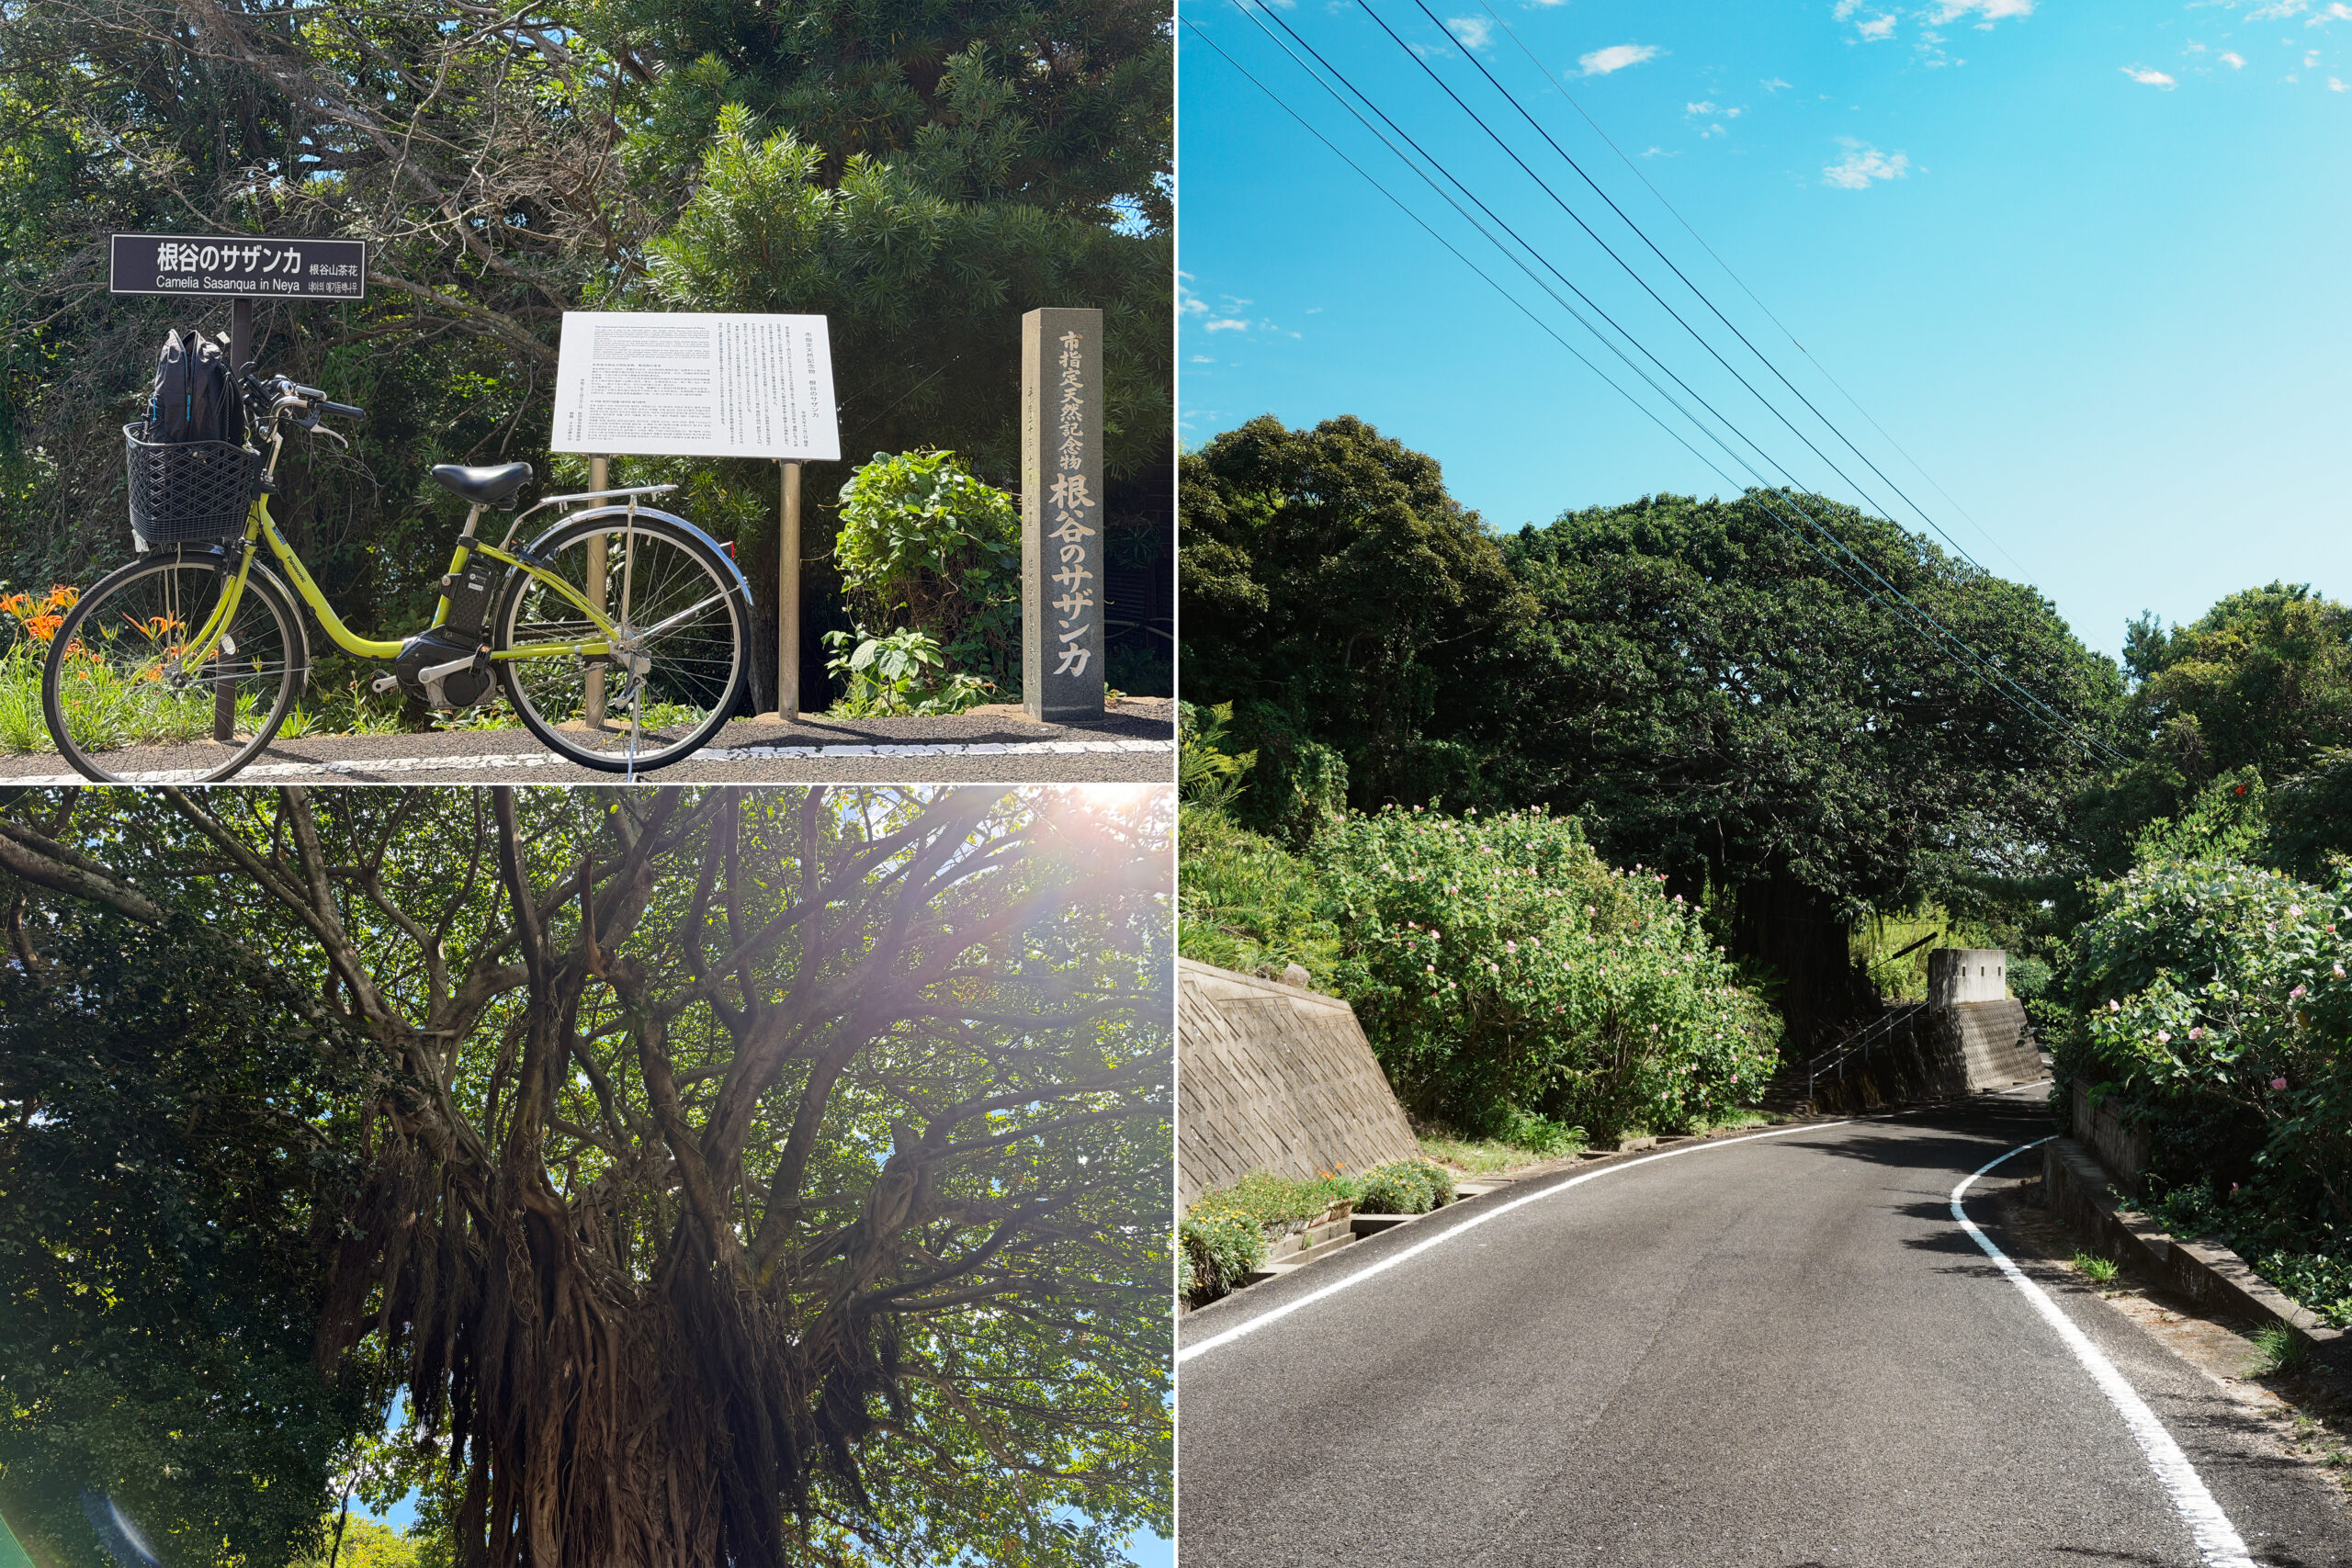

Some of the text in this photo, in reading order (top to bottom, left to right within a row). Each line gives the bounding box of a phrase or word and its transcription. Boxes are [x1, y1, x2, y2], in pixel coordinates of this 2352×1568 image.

[157, 243, 301, 274] 根谷のサザンカ
[309, 264, 358, 276] 根谷山茶花
[156, 275, 300, 294] Camelia Sasanqua in Neya
[1047, 331, 1096, 677] 市指定天然記念物 根谷のサザンカ
[287, 555, 307, 583] Panasonic
